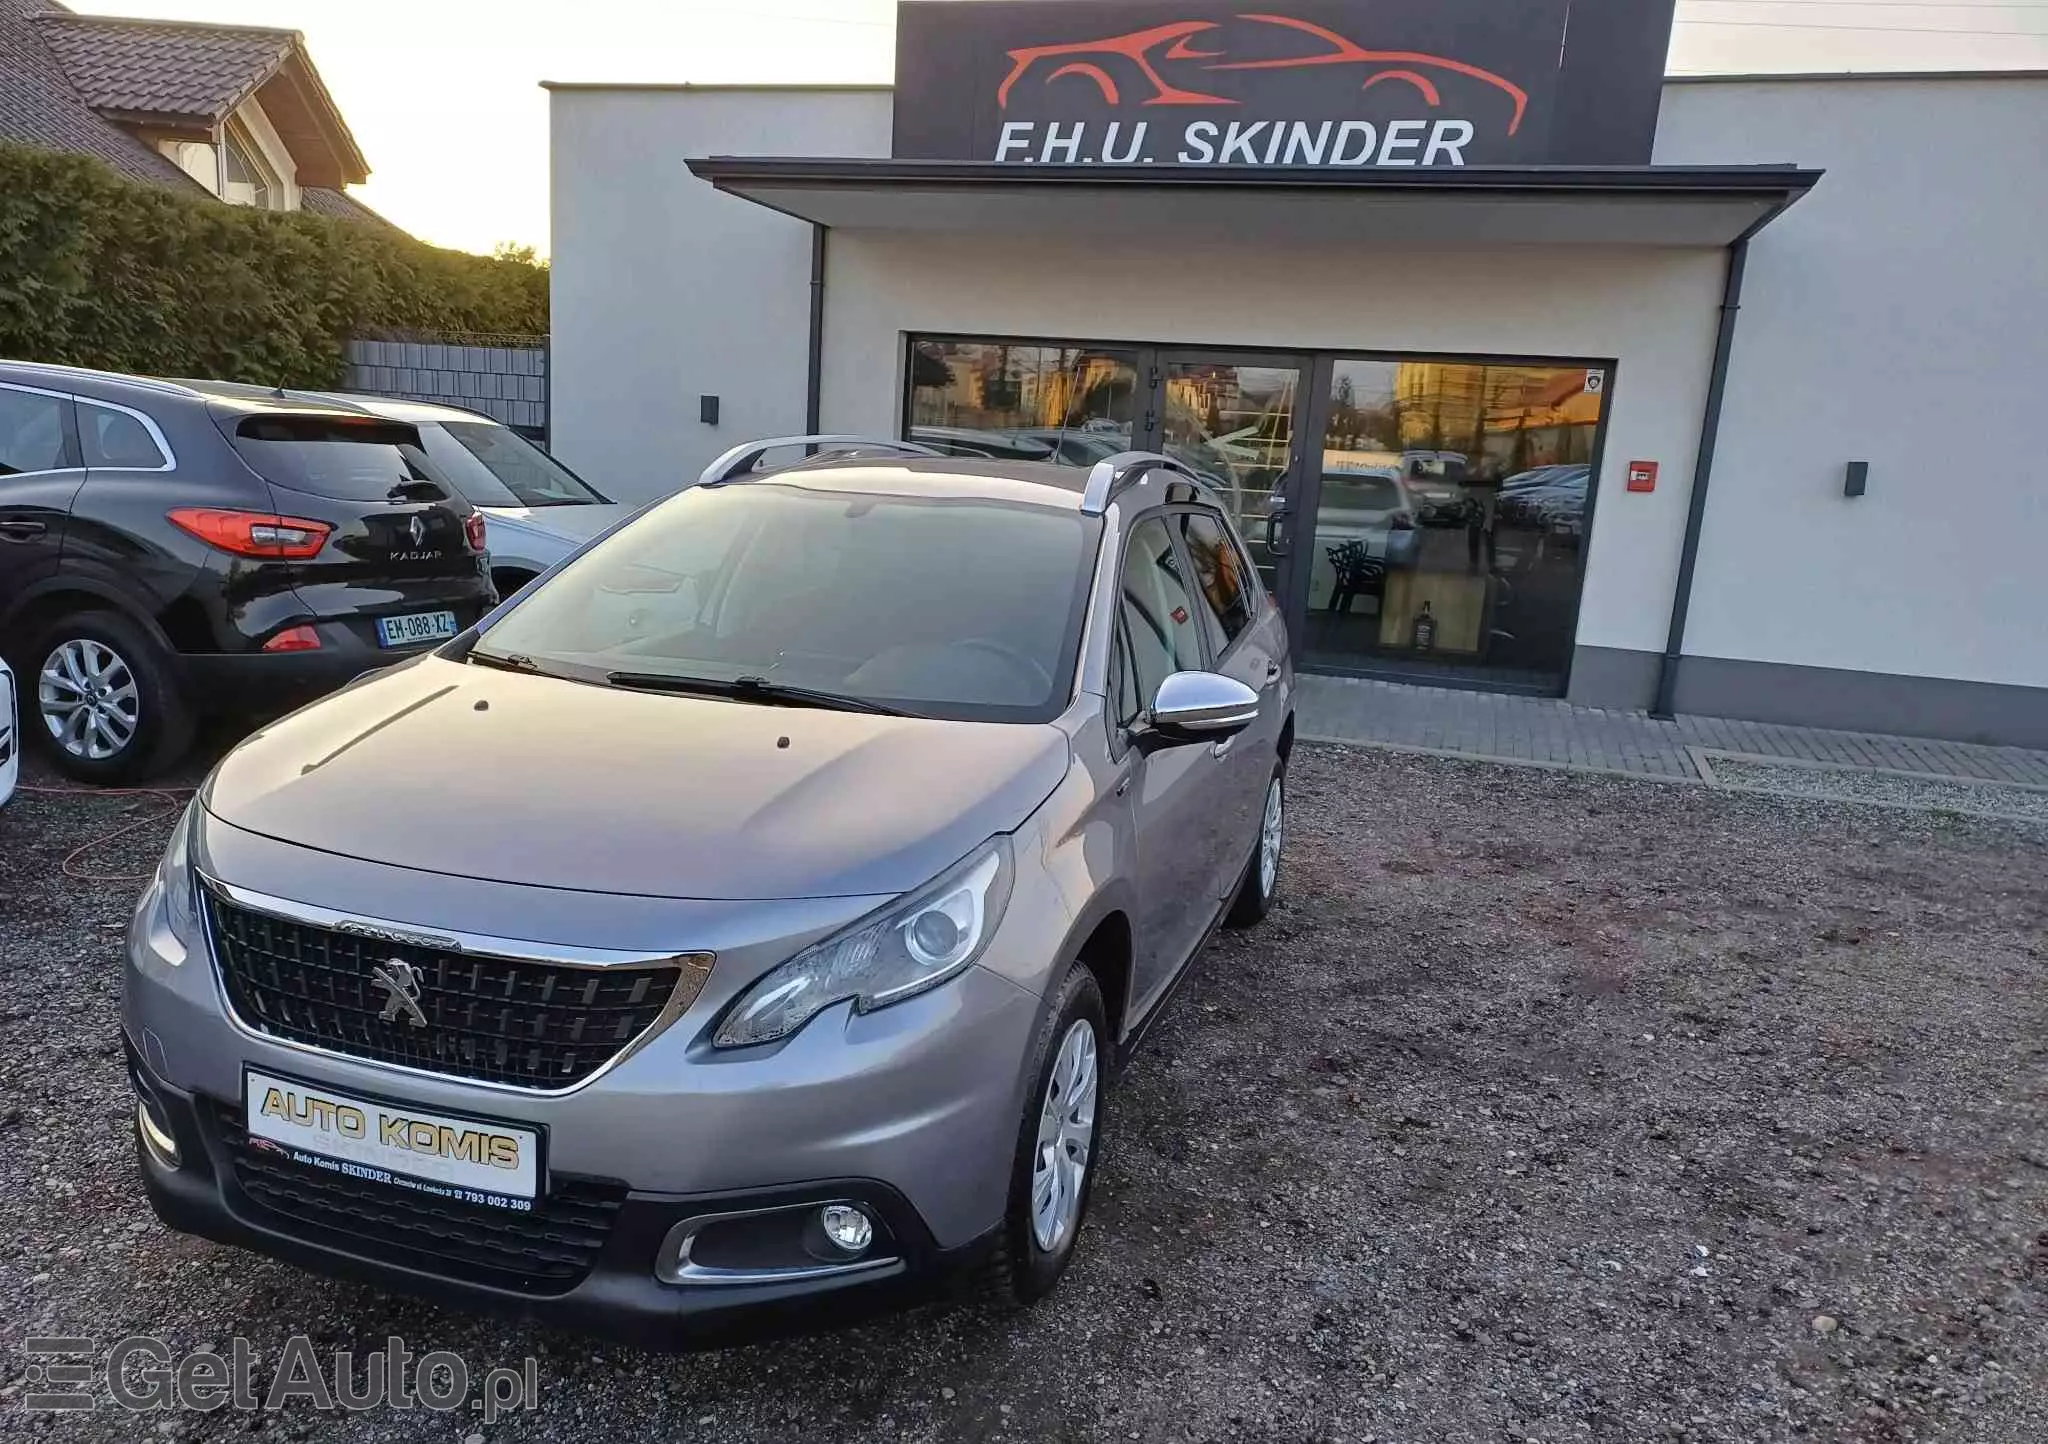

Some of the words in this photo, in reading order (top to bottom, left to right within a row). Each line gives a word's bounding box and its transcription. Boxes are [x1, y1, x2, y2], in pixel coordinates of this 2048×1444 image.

[994, 121, 1153, 163] F.H.U.
[1177, 119, 1474, 166] SKINDER
[390, 551, 444, 561] KADJAR
[261, 1087, 366, 1140] AUTO
[379, 1113, 519, 1170] KOMIS
[293, 1151, 312, 1165] Auto
[314, 1156, 340, 1171] Komis
[341, 1163, 392, 1185] SKINDER
[465, 1191, 485, 1205] 793
[487, 1195, 508, 1208] 002
[510, 1198, 532, 1211] 309
